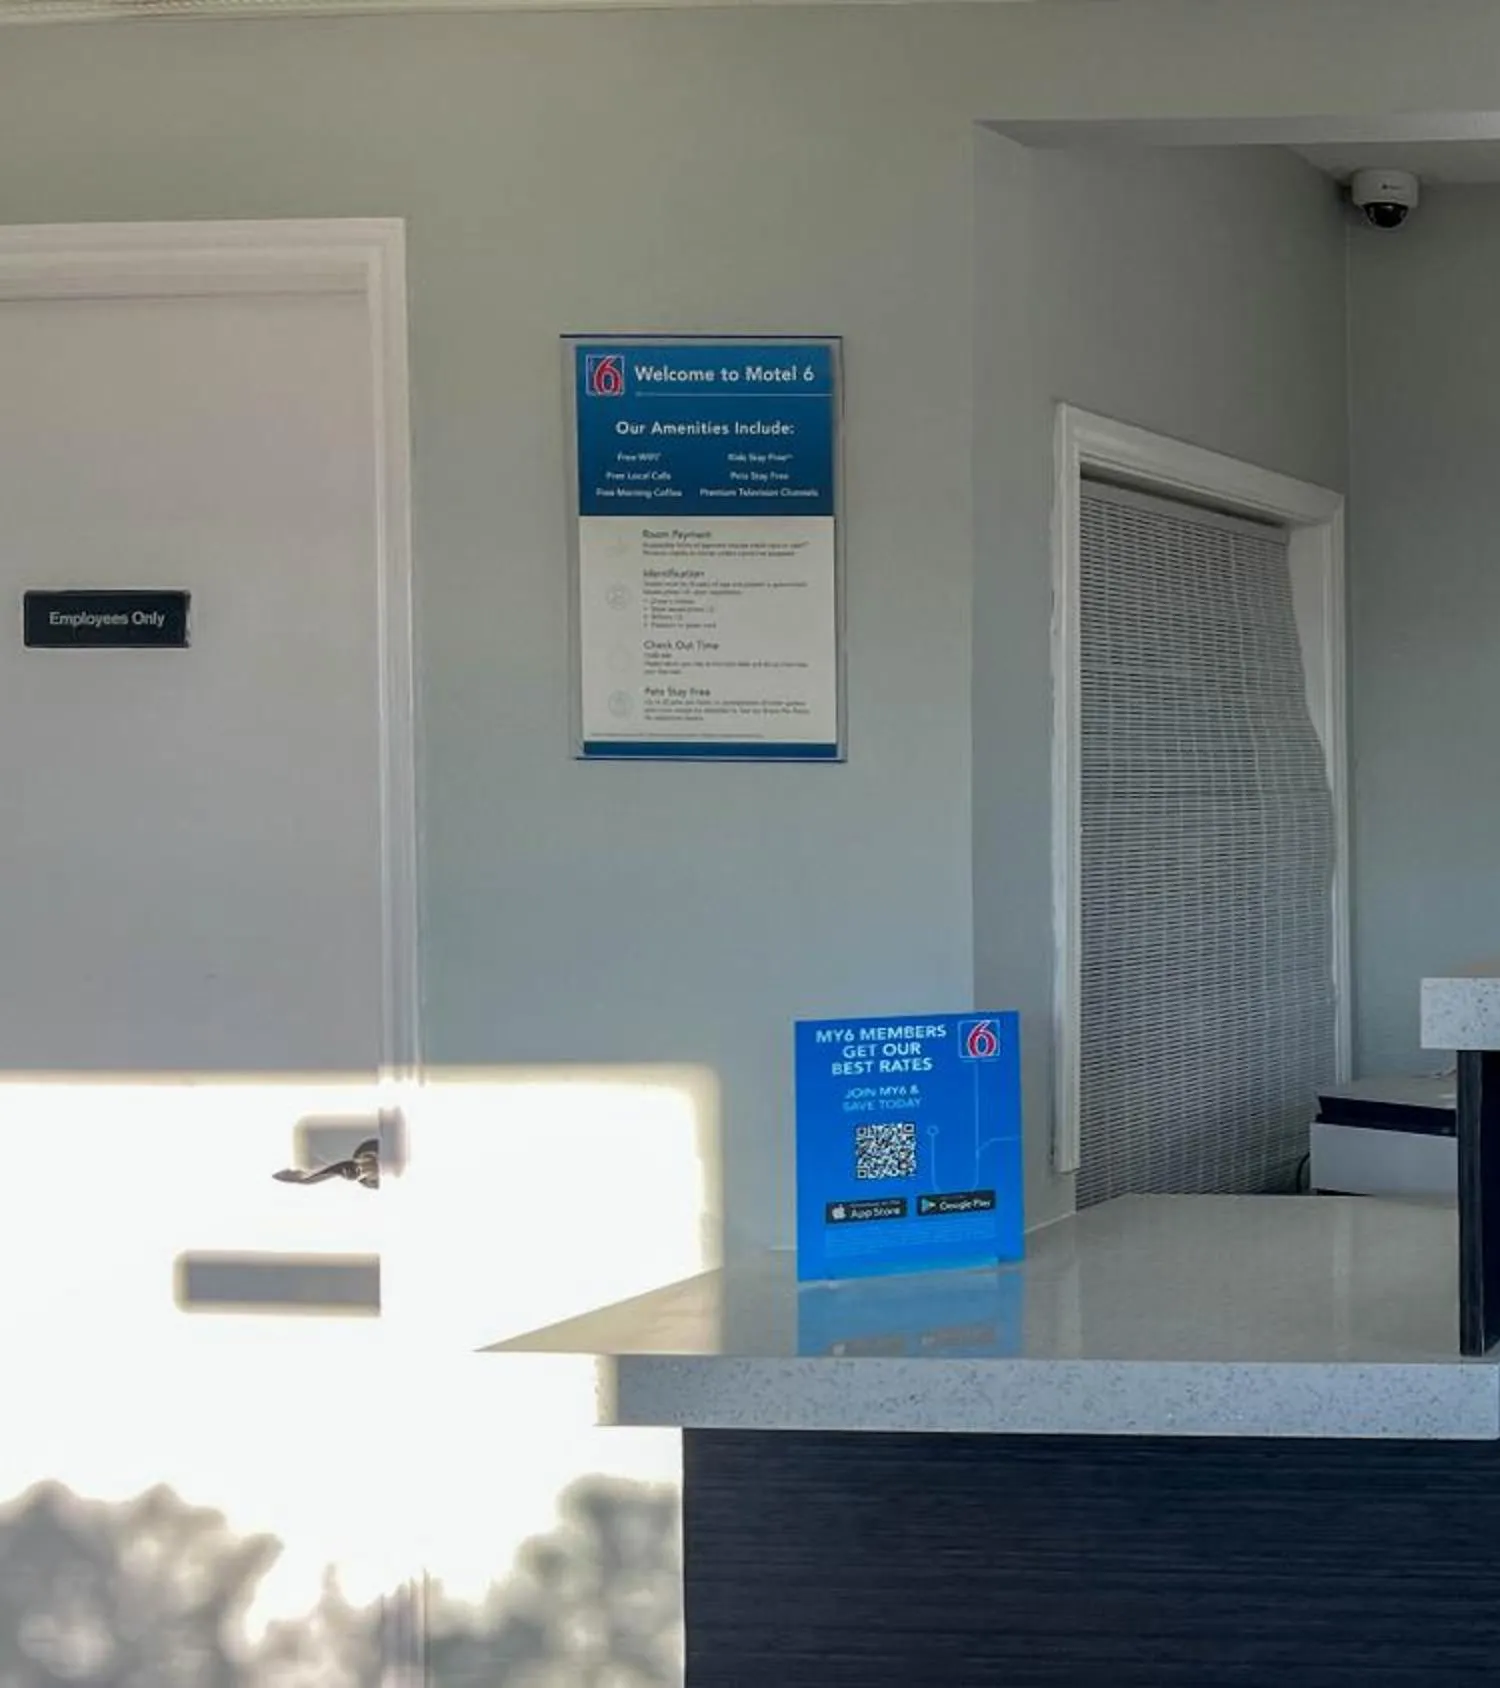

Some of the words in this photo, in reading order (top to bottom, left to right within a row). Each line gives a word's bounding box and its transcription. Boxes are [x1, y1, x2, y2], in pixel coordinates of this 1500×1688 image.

[634, 365, 715, 382] Welcome
[720, 367, 739, 382] to
[745, 365, 797, 382] Motel
[802, 366, 815, 382] 6
[615, 420, 645, 436] Our
[651, 420, 729, 436] Amenities
[734, 420, 795, 436] Include:
[49, 611, 128, 628] Employees
[131, 611, 165, 628] Only
[643, 640, 672, 650] Check
[675, 640, 693, 650] Out
[697, 640, 719, 650] Time
[690, 687, 711, 697] Free
[816, 1029, 855, 1043] MY6
[860, 1024, 947, 1042] MEMBERS
[843, 1044, 876, 1059] GET
[882, 1042, 921, 1057] OUR
[832, 1061, 874, 1076] BEST
[879, 1057, 933, 1073] RATES
[845, 1088, 876, 1099] JOIN
[879, 1086, 907, 1097] MY6
[842, 1101, 876, 1112] SAVE
[879, 1098, 922, 1109] TODAY
[850, 1208, 873, 1219] App
[874, 1205, 901, 1217] Store
[939, 1200, 972, 1212] Google
